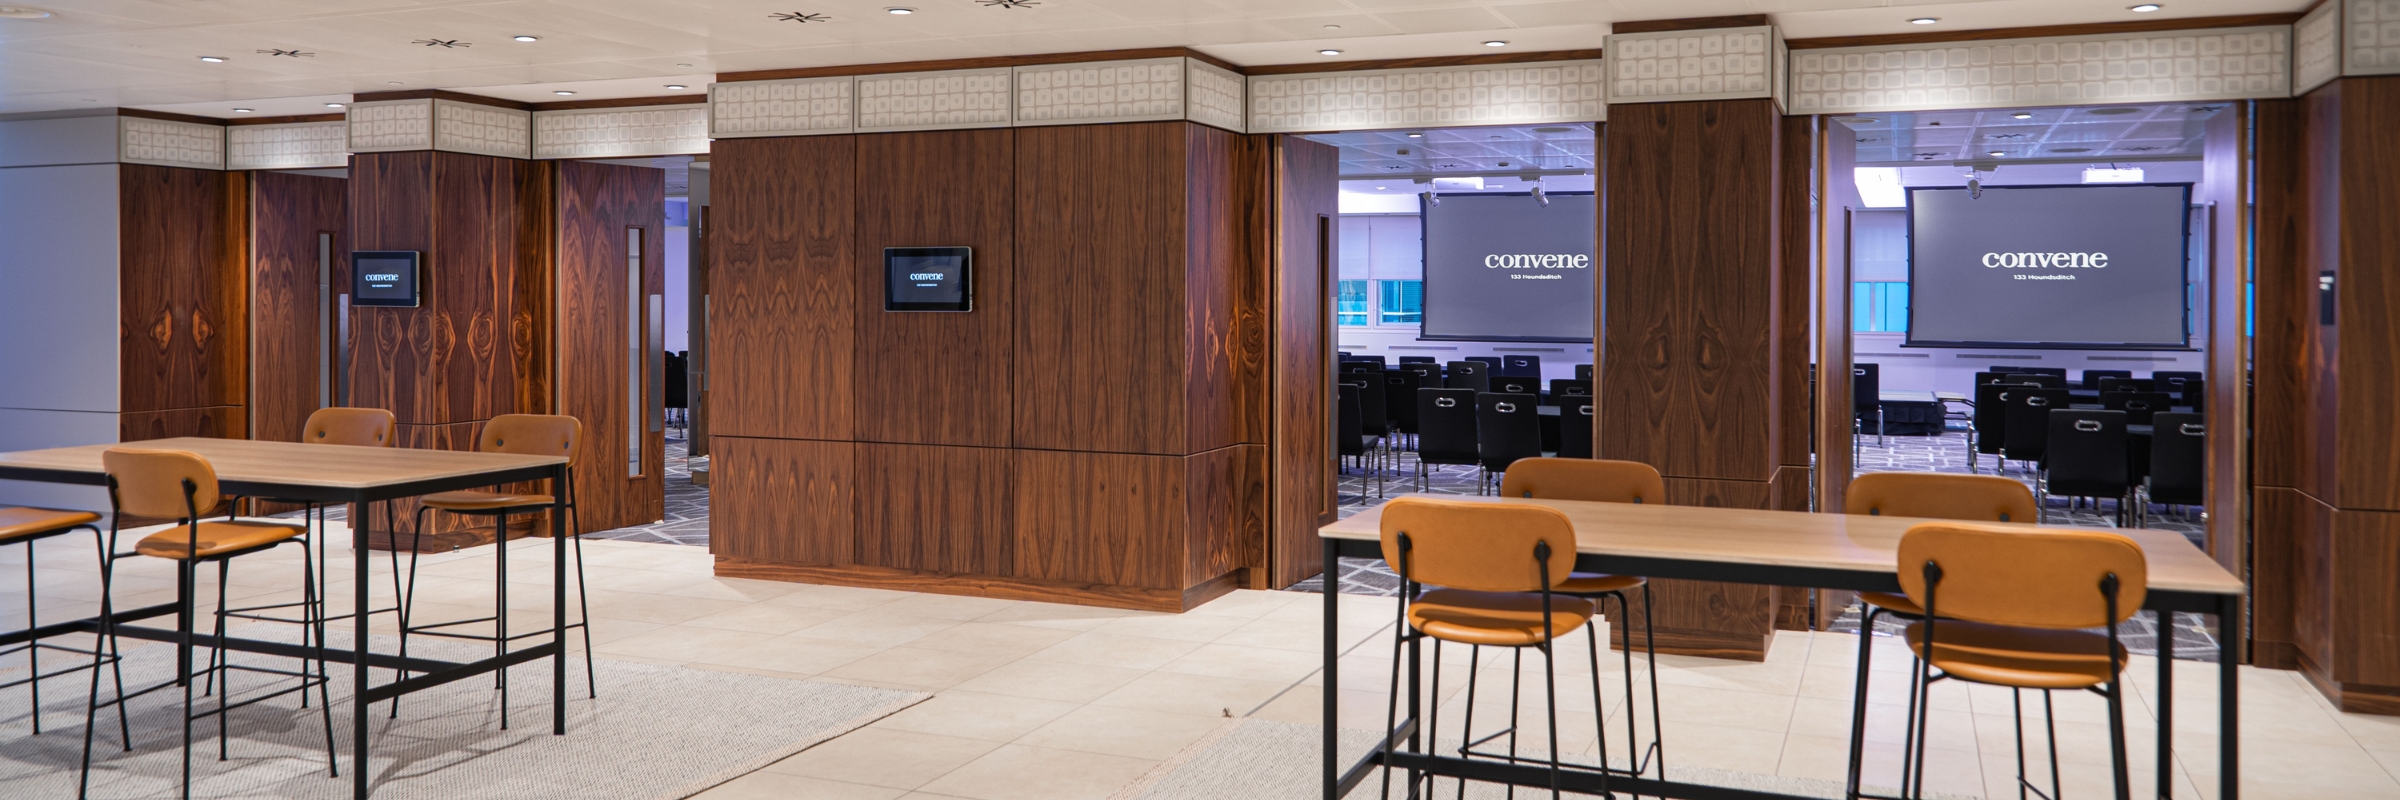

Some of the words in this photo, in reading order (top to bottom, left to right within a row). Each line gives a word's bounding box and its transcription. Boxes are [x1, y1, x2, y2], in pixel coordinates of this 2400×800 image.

[1484, 253, 1589, 269] convene
[1981, 252, 2109, 268] convene
[365, 273, 399, 281] convene
[910, 272, 944, 281] convene
